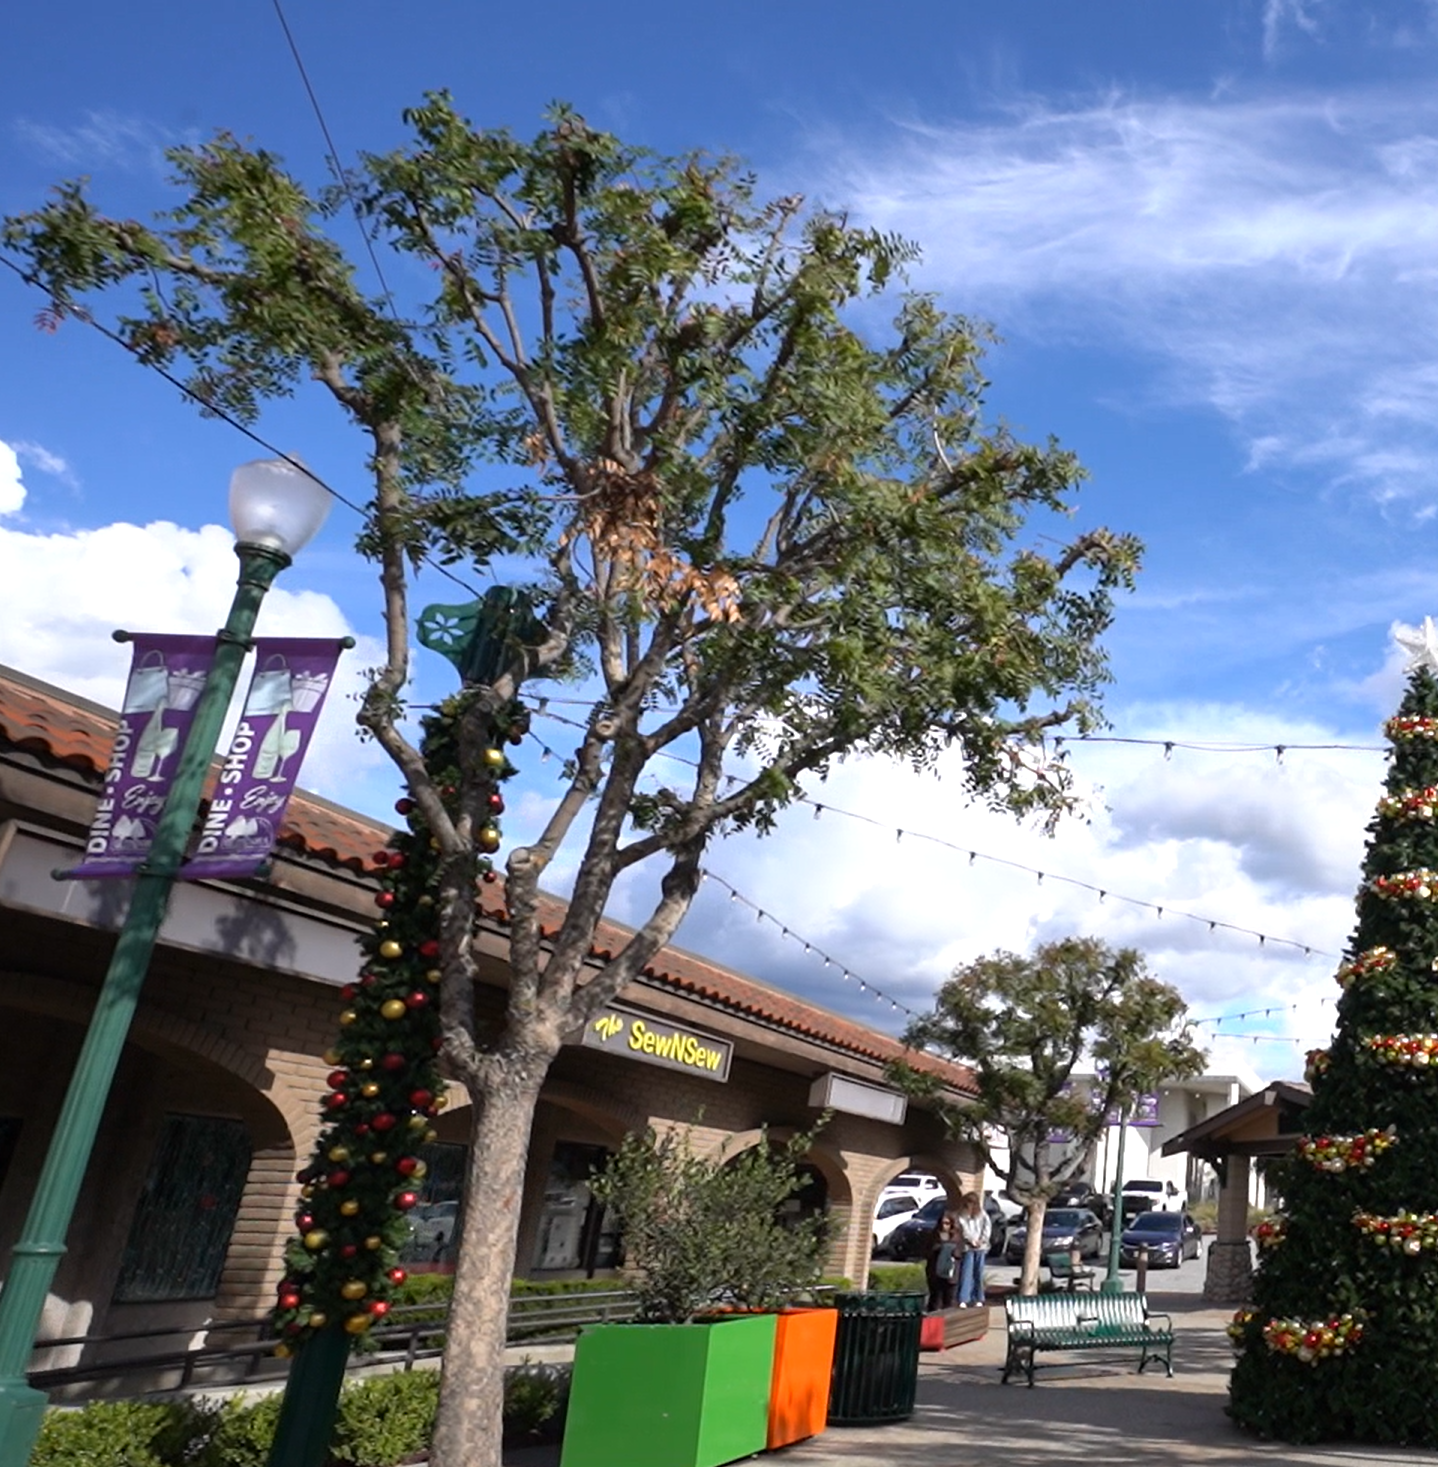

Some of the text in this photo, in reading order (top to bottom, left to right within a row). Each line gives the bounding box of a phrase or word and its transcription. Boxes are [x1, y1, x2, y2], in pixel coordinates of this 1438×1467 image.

[87, 720, 133, 853] DINE SHOP
[197, 799, 233, 853] DINE
[220, 721, 255, 784] SHOP
[239, 785, 287, 814] Enjoy
[594, 1013, 722, 1072] The SewNSew
